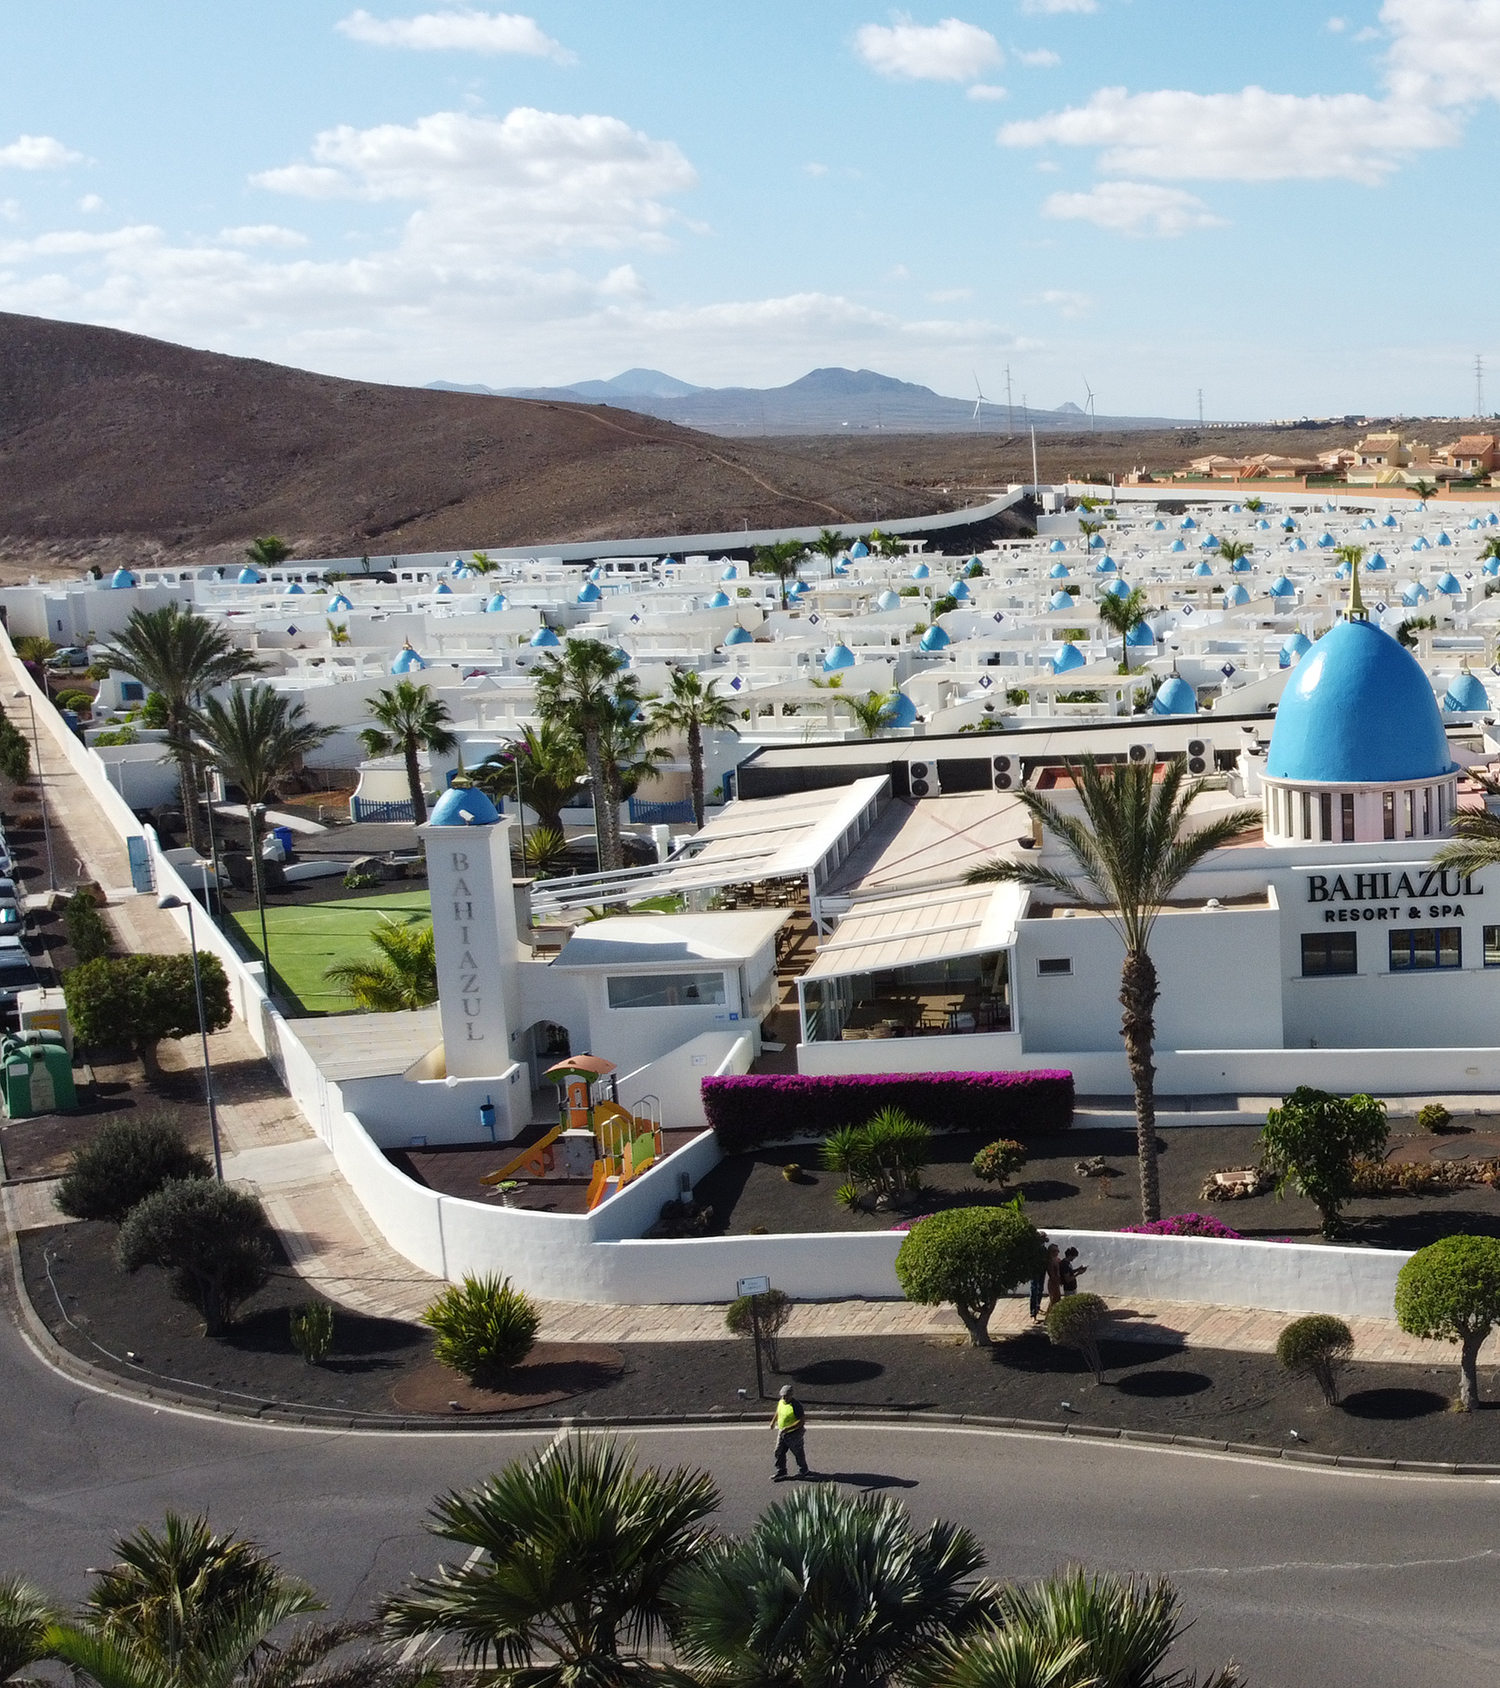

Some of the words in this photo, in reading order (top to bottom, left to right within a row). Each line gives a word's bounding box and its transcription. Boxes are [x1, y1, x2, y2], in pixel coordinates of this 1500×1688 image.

[1307, 871, 1484, 903] BAHIAZUL
[1325, 907, 1400, 922] RESORT
[1408, 906, 1421, 919] &
[1429, 904, 1465, 918] SPA
[451, 852, 484, 1041] BAHIAZUL
